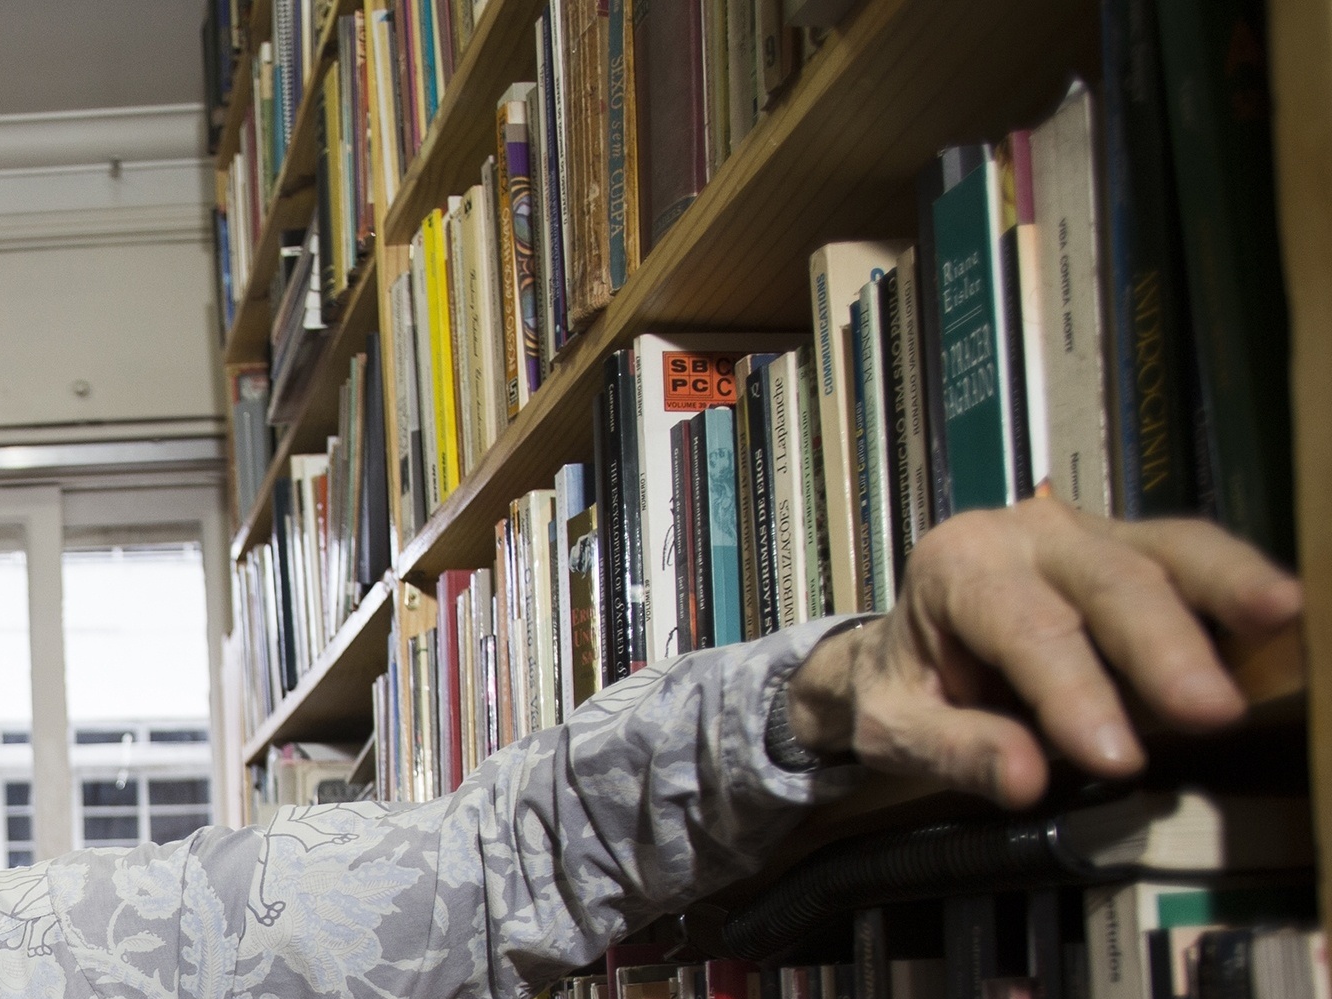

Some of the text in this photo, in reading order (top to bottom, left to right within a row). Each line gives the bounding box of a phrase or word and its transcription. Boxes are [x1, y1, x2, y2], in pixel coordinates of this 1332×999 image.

[610, 55, 623, 239] SEXO sem CULPA
[943, 250, 979, 284] Riane
[943, 279, 982, 314] Eisler
[814, 272, 834, 396] COMMUNICATIONS
[671, 358, 708, 374] SB
[672, 378, 708, 392] PC
[772, 377, 788, 475] J. Laplanche
[801, 410, 809, 455] SAGRADO
[692, 436, 701, 499] Metamorfoses
[803, 457, 809, 469] LO
[675, 500, 681, 511] do
[804, 480, 812, 529] FEMENINO
[675, 515, 683, 554] erotismo
[807, 533, 813, 544] LO
[609, 460, 626, 654] THE ENCYCLOPEDIA OF SACRED
[809, 578, 817, 616] KRISTEVA
